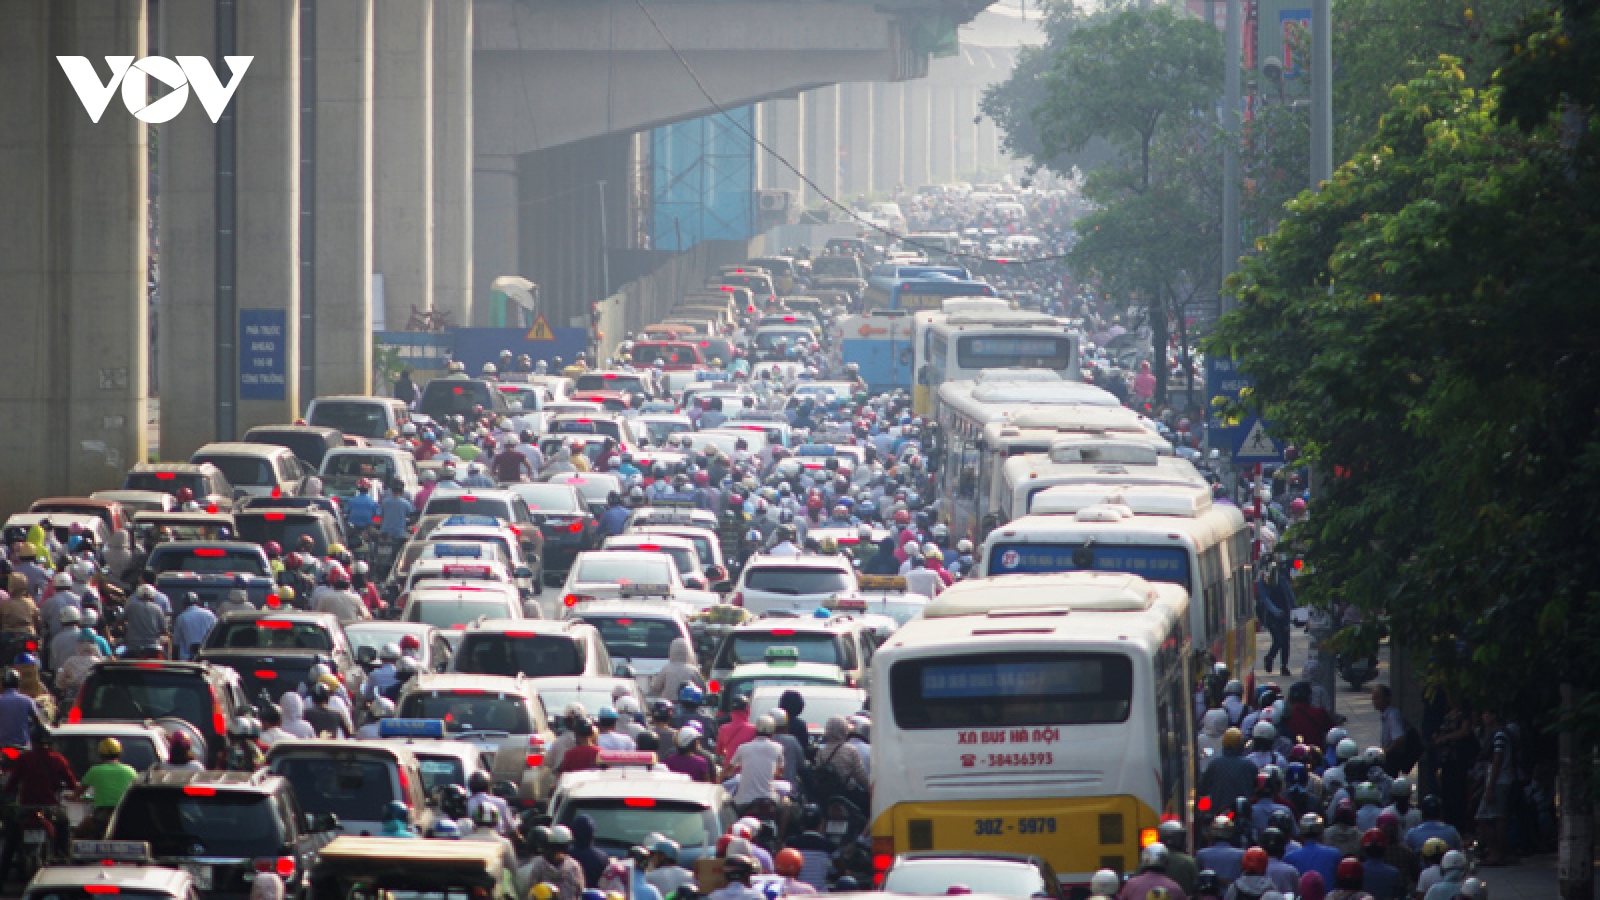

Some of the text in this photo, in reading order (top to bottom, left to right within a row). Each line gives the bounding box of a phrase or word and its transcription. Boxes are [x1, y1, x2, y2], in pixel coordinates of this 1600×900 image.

[980, 730, 1006, 744] BUS
[1009, 727, 1029, 743] HÀ
[1031, 725, 1060, 746] NỘI
[988, 752, 1053, 767] 38436393
[974, 817, 1003, 836] 30Z
